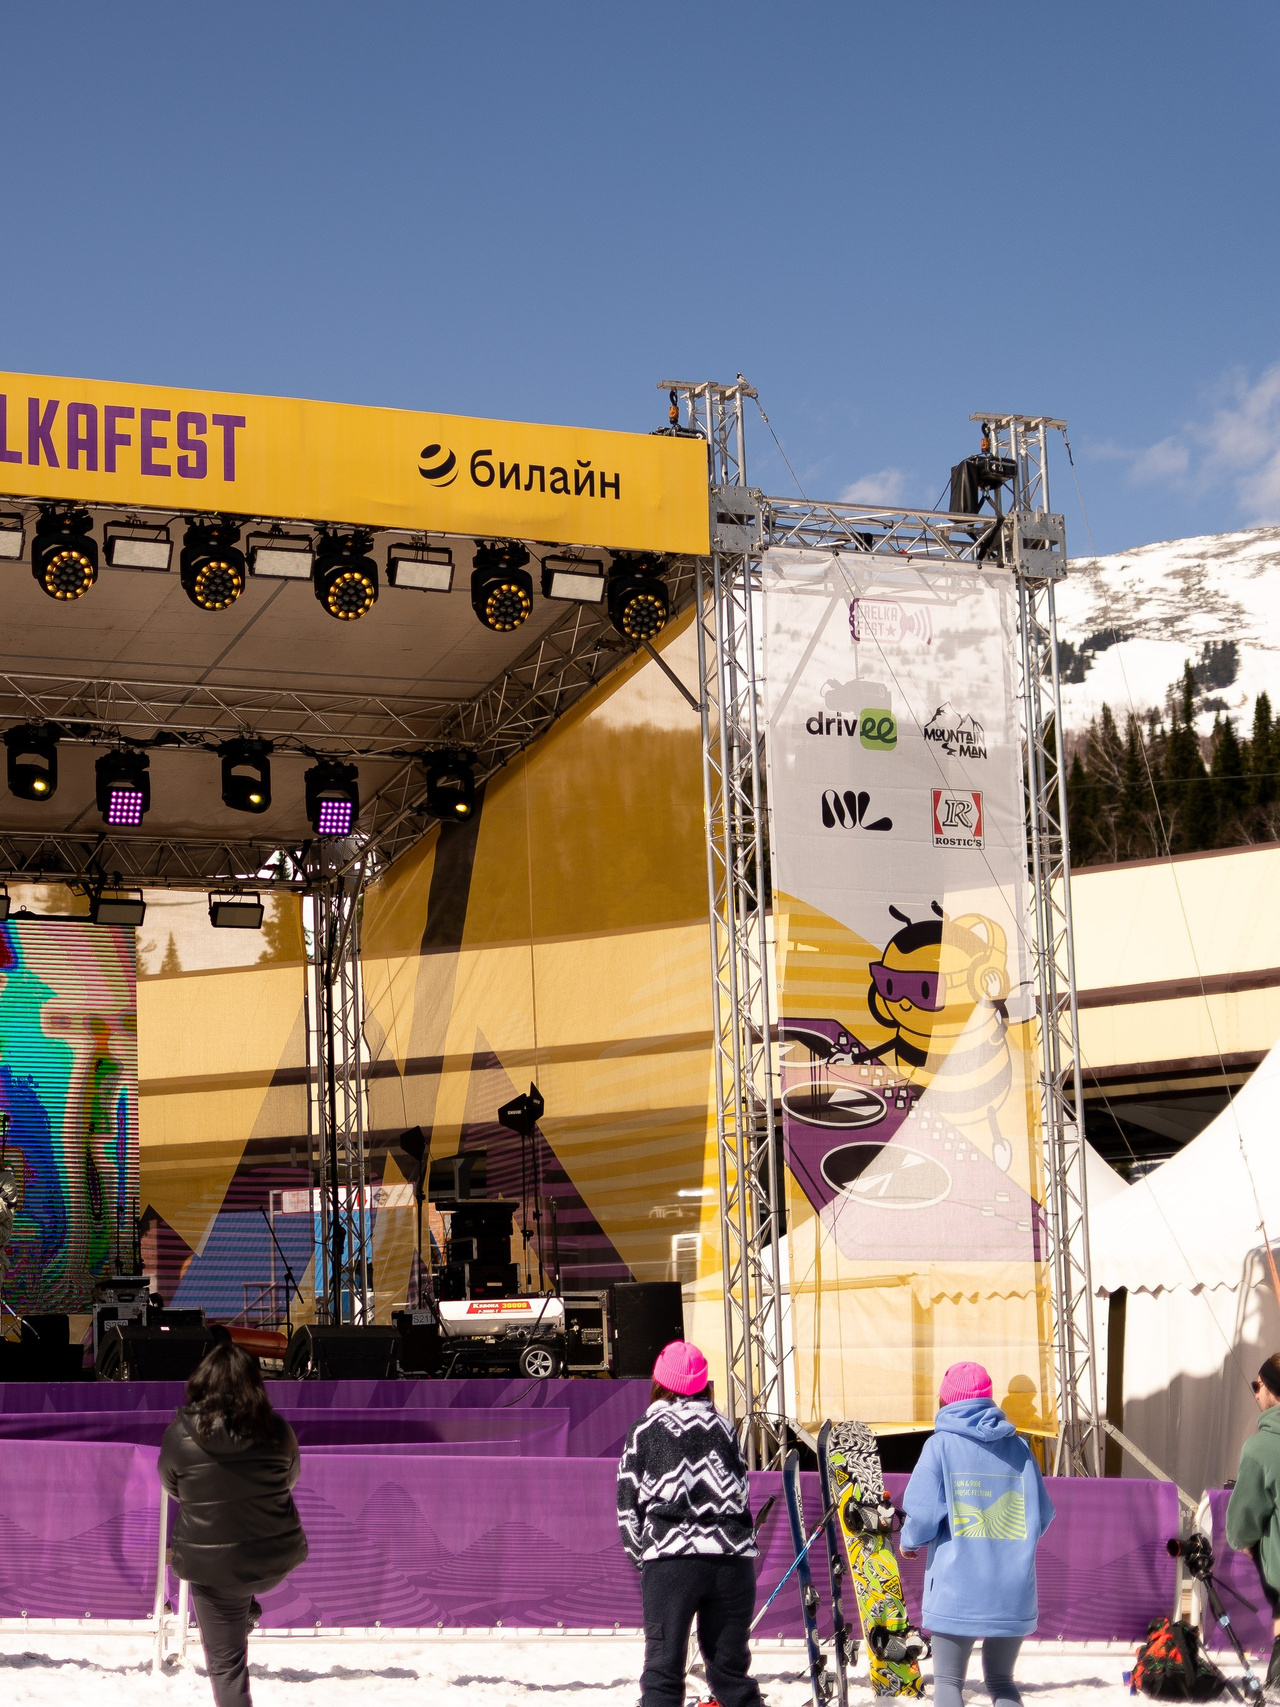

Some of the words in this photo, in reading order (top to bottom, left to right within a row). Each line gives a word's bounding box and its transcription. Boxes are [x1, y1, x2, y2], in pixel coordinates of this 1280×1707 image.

[469, 448, 621, 500] билайн
[805, 711, 897, 744] drivee
[959, 744, 987, 760] MAN
[935, 836, 982, 848] ROSTIC'S
